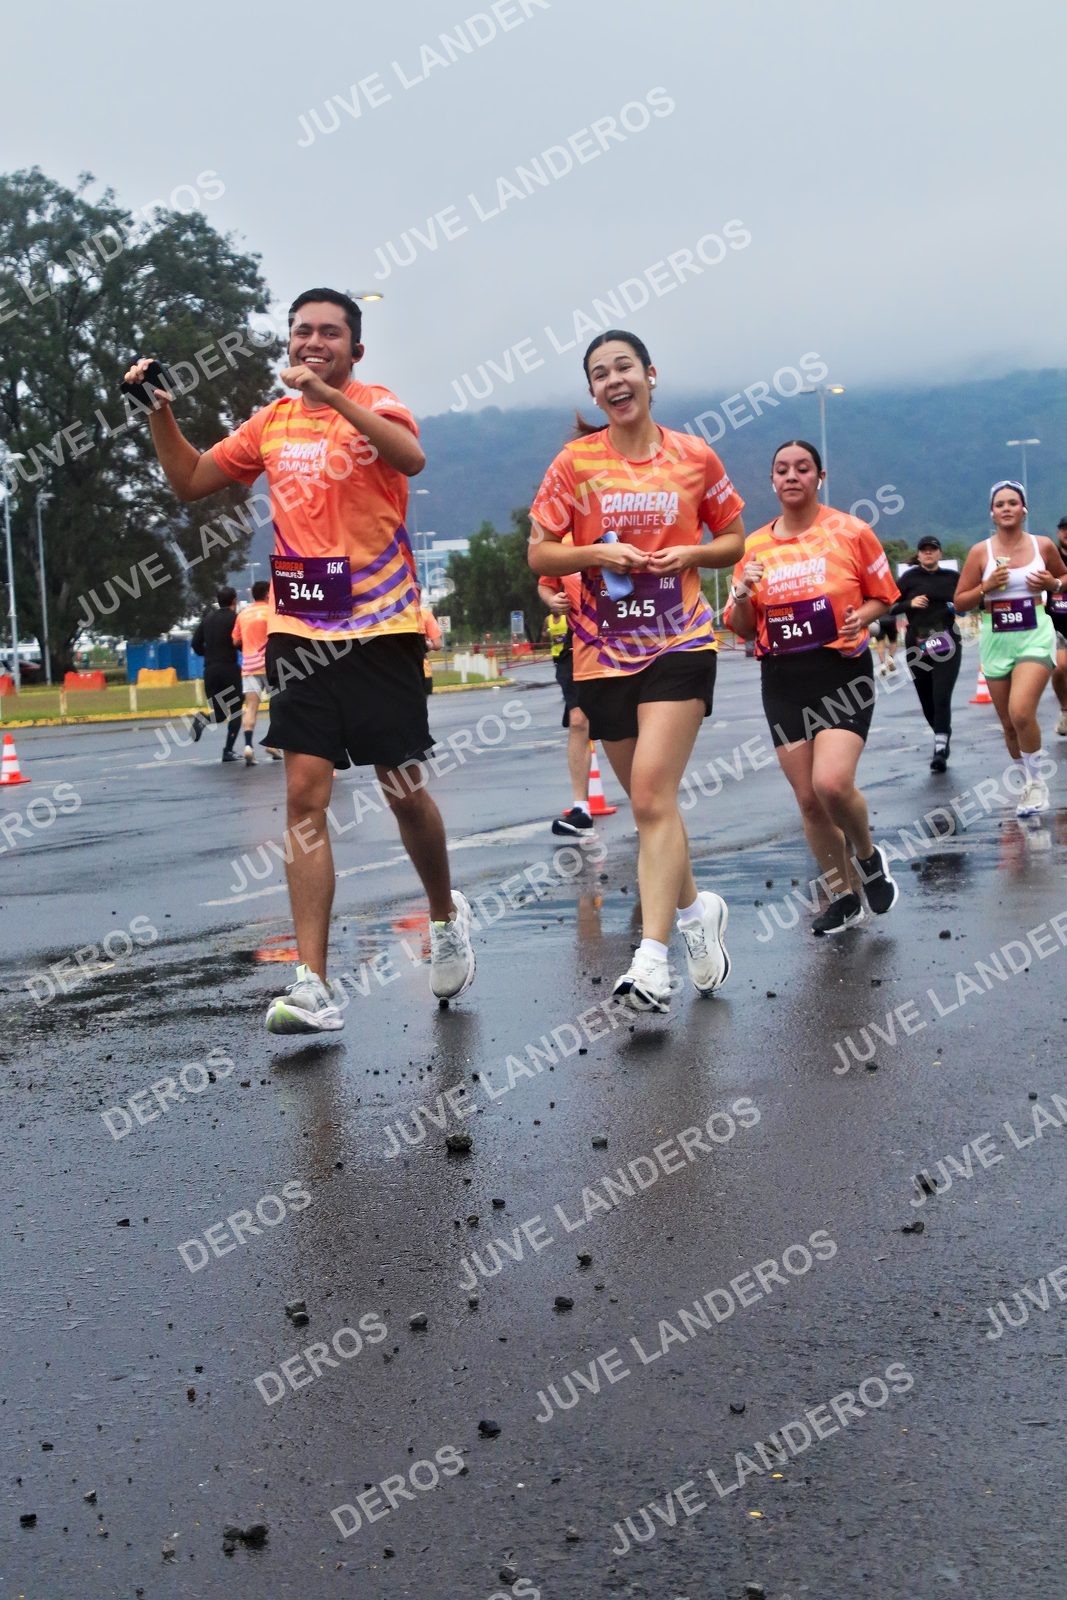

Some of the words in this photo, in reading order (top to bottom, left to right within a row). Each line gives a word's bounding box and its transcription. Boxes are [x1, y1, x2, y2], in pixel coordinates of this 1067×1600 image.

[601, 491, 679, 514] CARRERA
[326, 562, 344, 574] 15K
[768, 557, 826, 585] CARRERA
[289, 582, 325, 601] 344
[659, 577, 676, 589] 15K
[616, 600, 656, 618] 345
[812, 599, 826, 612] 15K
[1001, 612, 1023, 624] 398
[781, 620, 813, 640] 341
